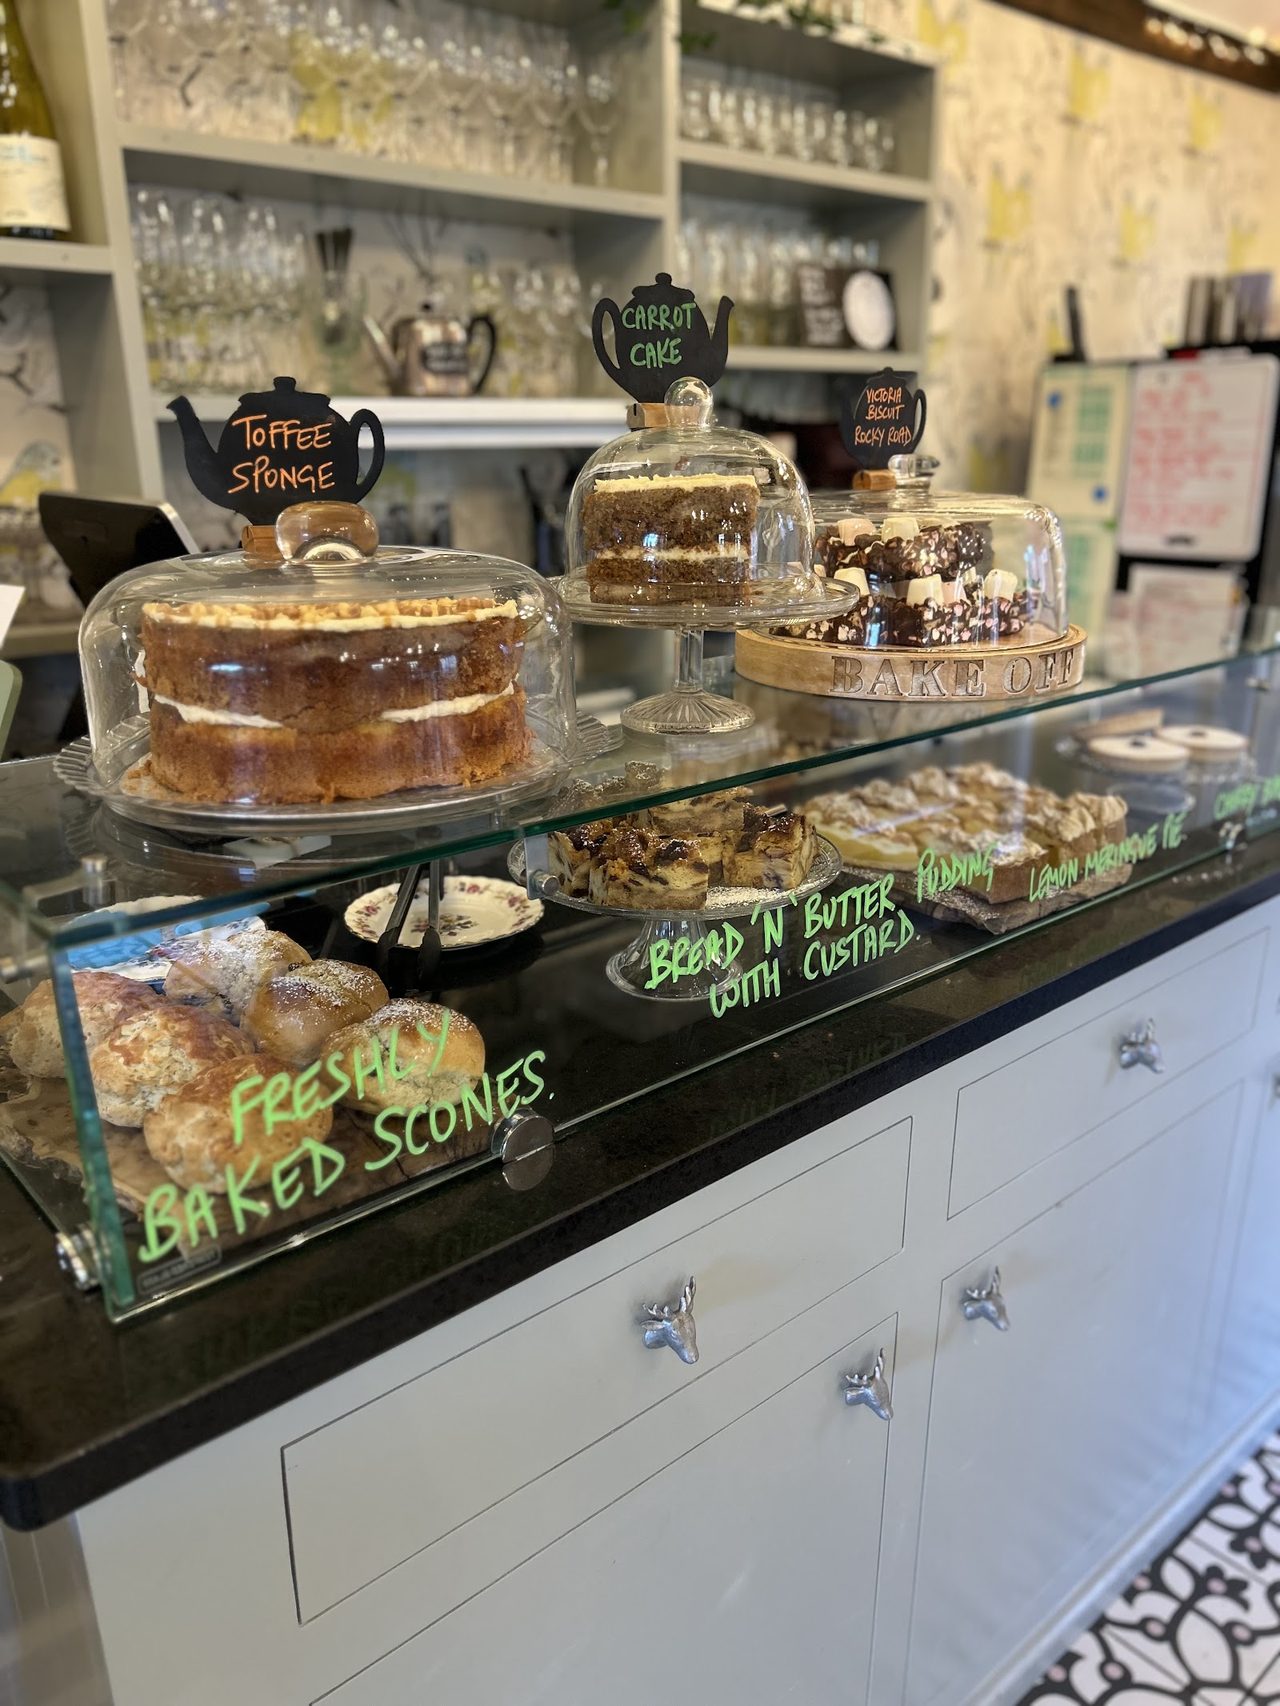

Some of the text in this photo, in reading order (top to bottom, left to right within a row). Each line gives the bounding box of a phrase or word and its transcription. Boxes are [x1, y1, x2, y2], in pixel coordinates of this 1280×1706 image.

[622, 303, 697, 332] CARROT
[630, 337, 682, 369] CAKE
[865, 404, 905, 421] BISCUIT
[866, 387, 902, 404] VICTORIA
[231, 414, 333, 450] TOFFEE
[854, 425, 912, 447] ROCKY ROAD
[227, 455, 335, 493] SPONGE
[829, 650, 1075, 698] BAKE OFF
[1029, 857, 1079, 903] LEMON
[644, 921, 745, 990] BREAD
[803, 873, 896, 939] BUTTER
[916, 842, 1000, 903] PUDDING
[708, 957, 781, 1019] WITH
[230, 1008, 452, 1145] FRESHLY
[138, 1137, 345, 1264] BAKED
